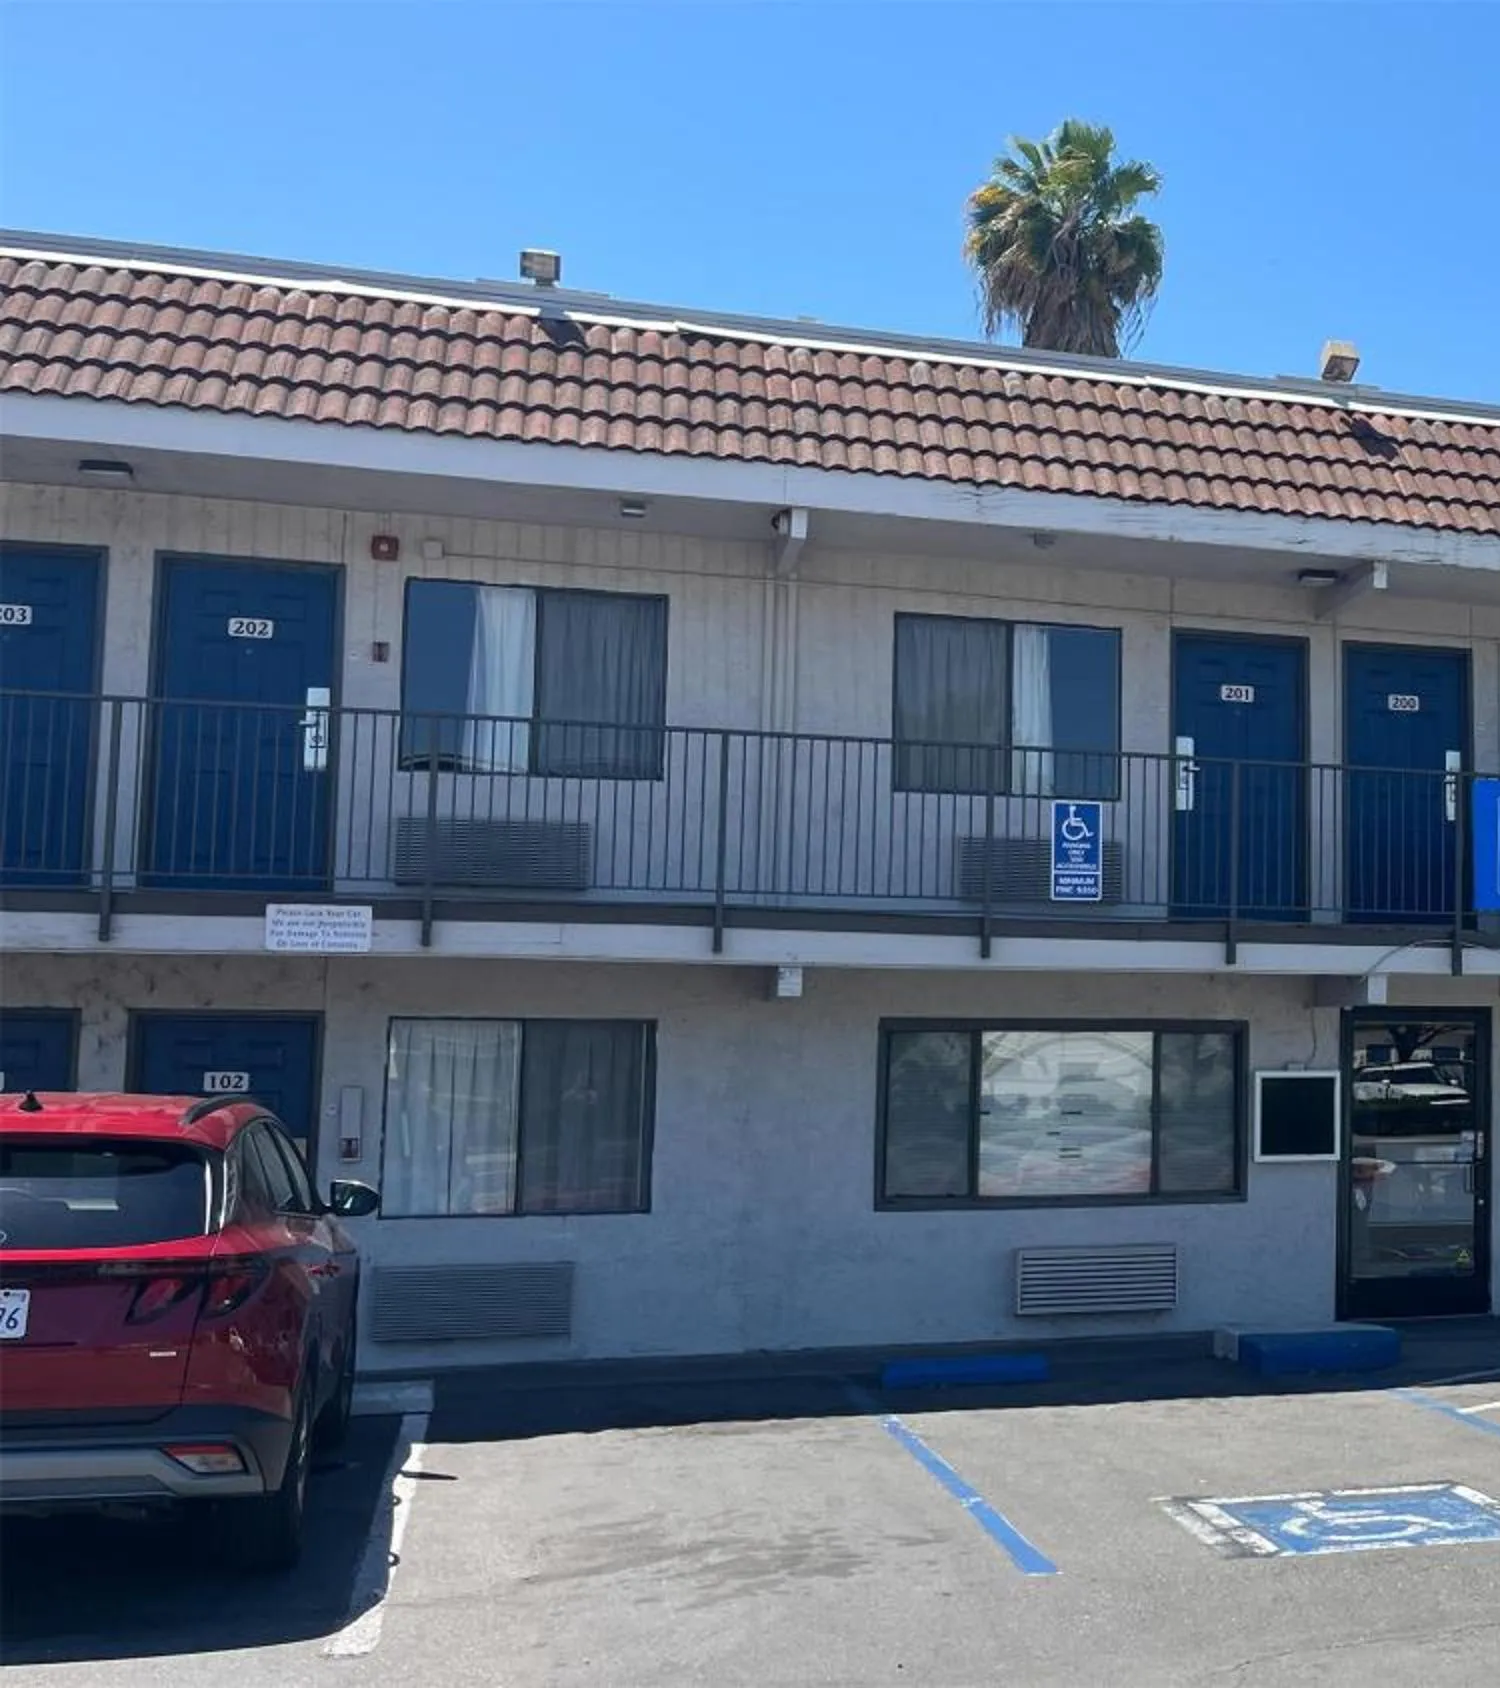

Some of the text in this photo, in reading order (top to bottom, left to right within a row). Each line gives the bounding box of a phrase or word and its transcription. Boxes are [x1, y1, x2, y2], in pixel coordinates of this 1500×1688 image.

[0, 607, 27, 622] 03
[231, 620, 270, 636] 202
[1224, 687, 1250, 701] 201
[1391, 697, 1416, 709] 200
[209, 1074, 244, 1089] 102
